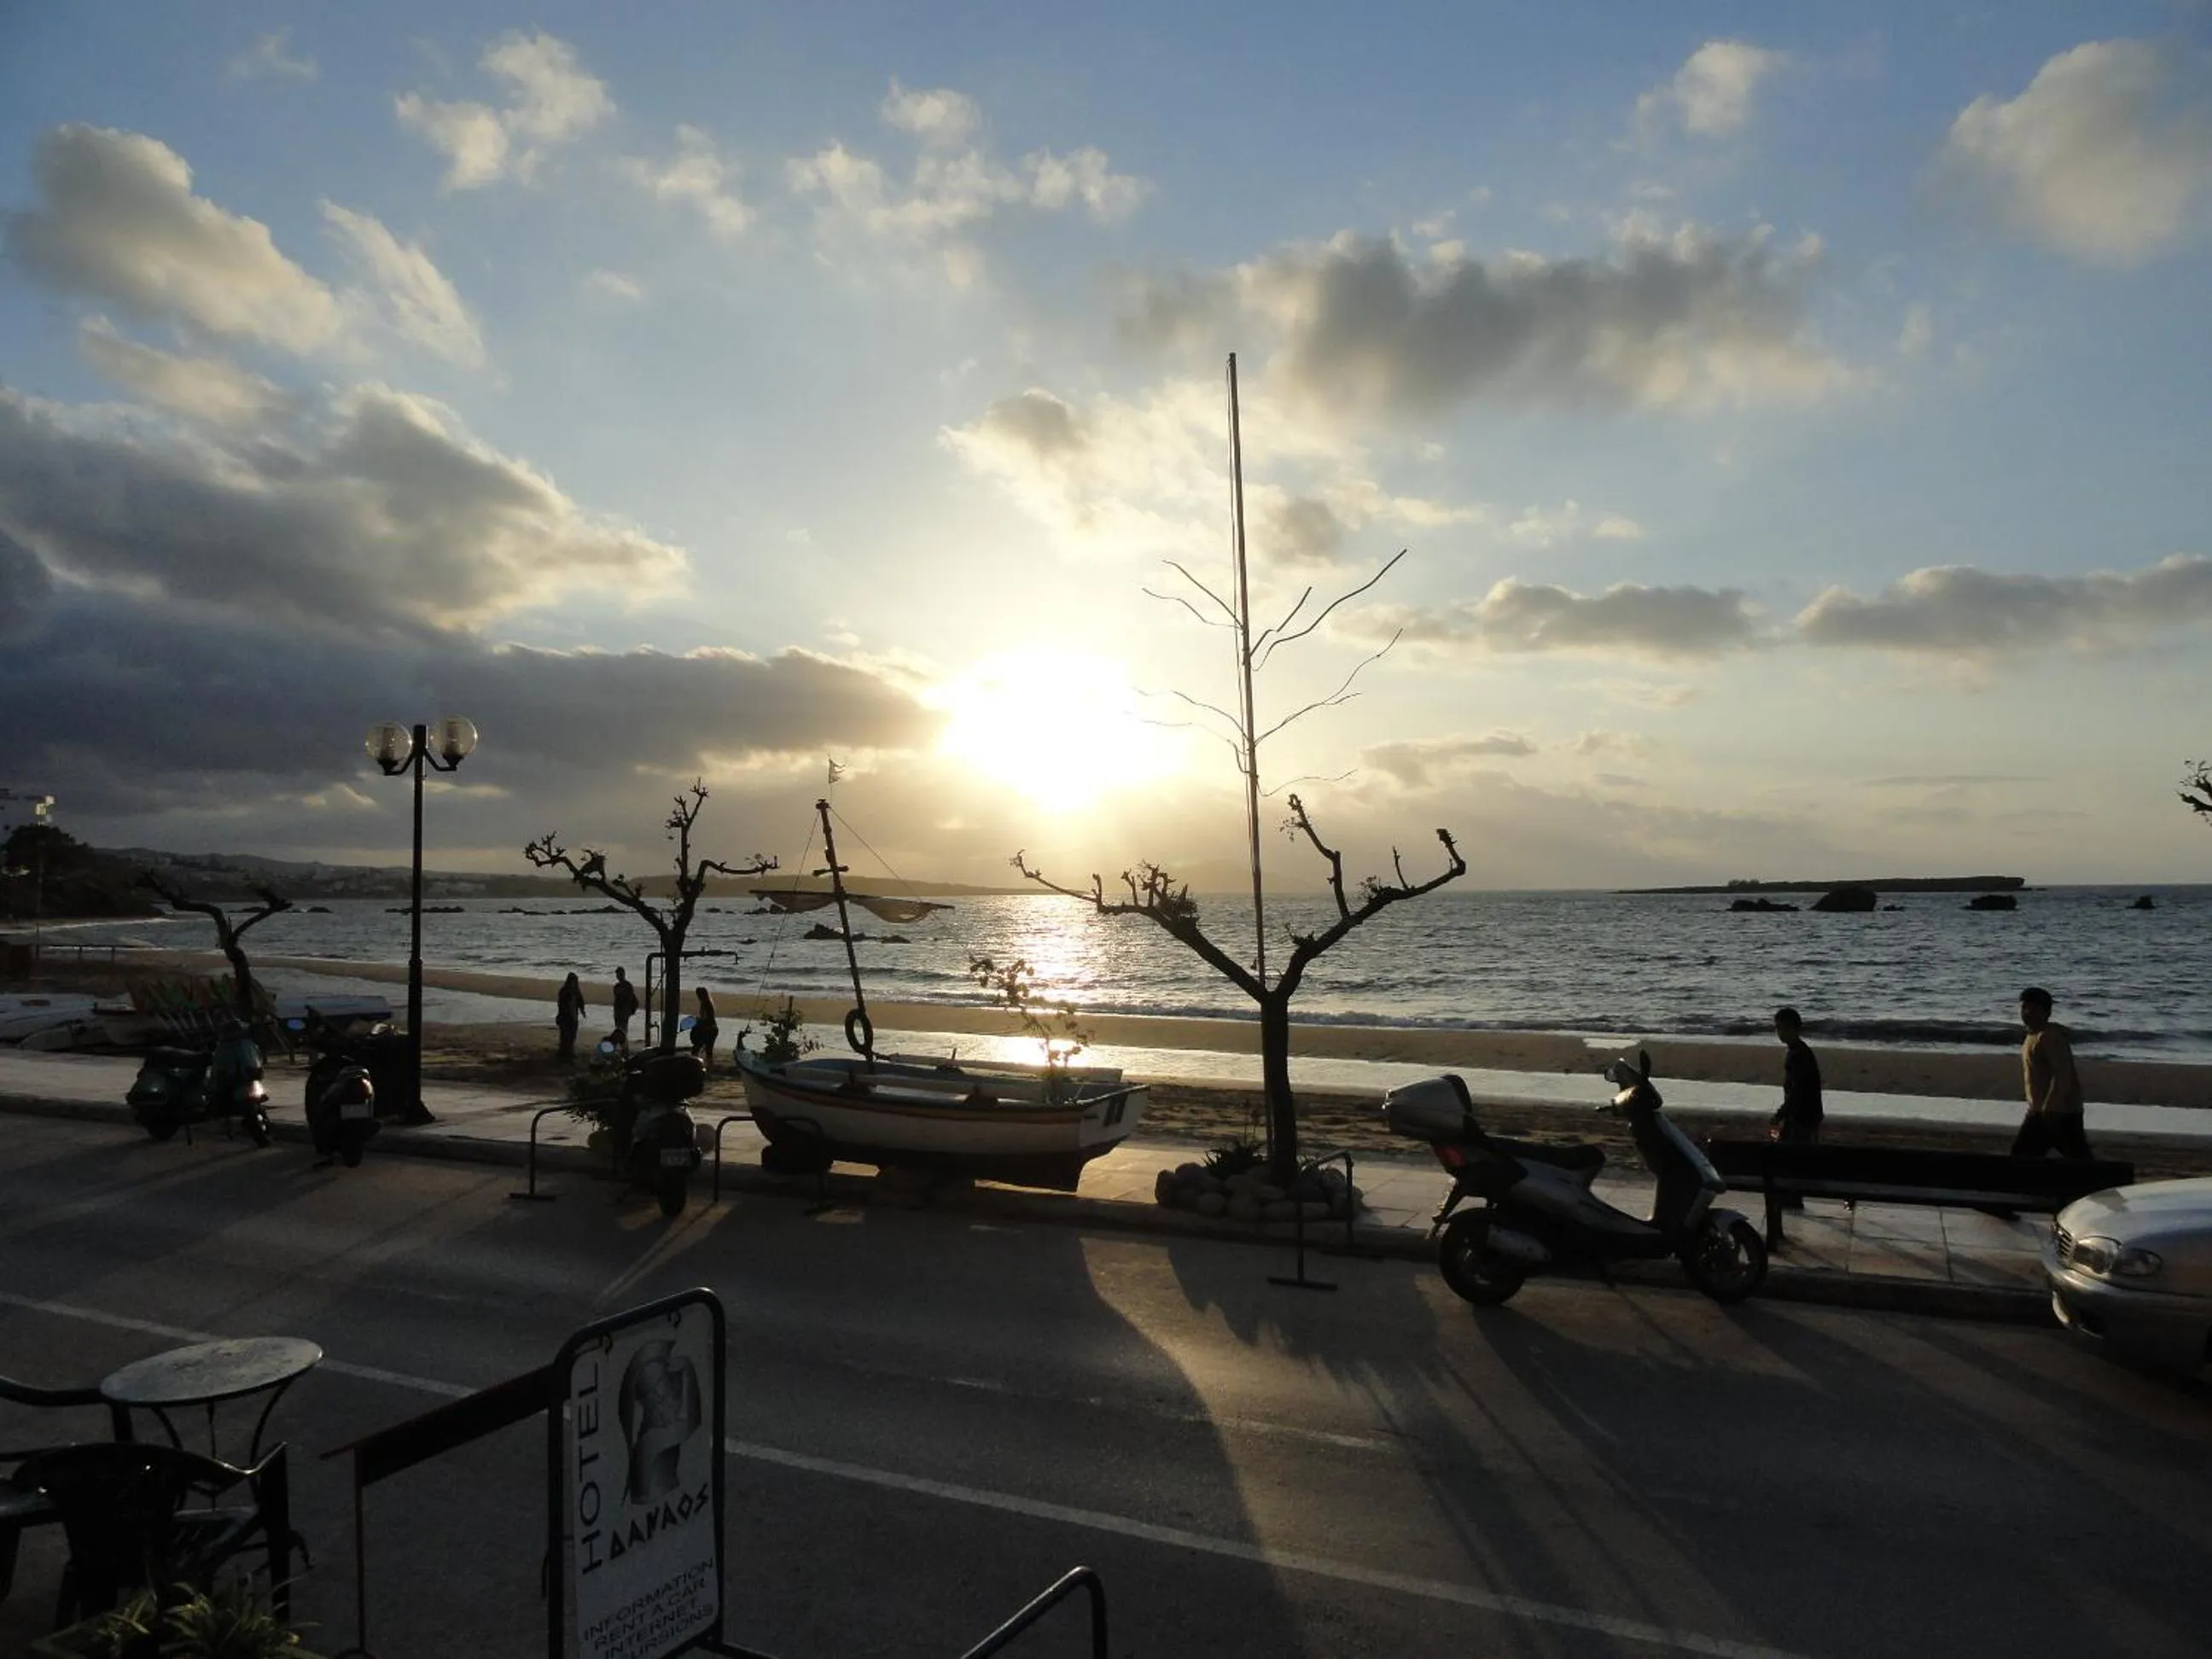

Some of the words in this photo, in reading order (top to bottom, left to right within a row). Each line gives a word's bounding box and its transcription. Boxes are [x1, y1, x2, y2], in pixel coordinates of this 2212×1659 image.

[578, 1362, 602, 1575] HOTEL
[584, 1557, 713, 1641] INFORMATION
[594, 1610, 646, 1650] RENT
[651, 1604, 664, 1618] A
[668, 1577, 706, 1605] CAR
[604, 1597, 698, 1659] INTERNET
[630, 1603, 713, 1659] URSIONS
